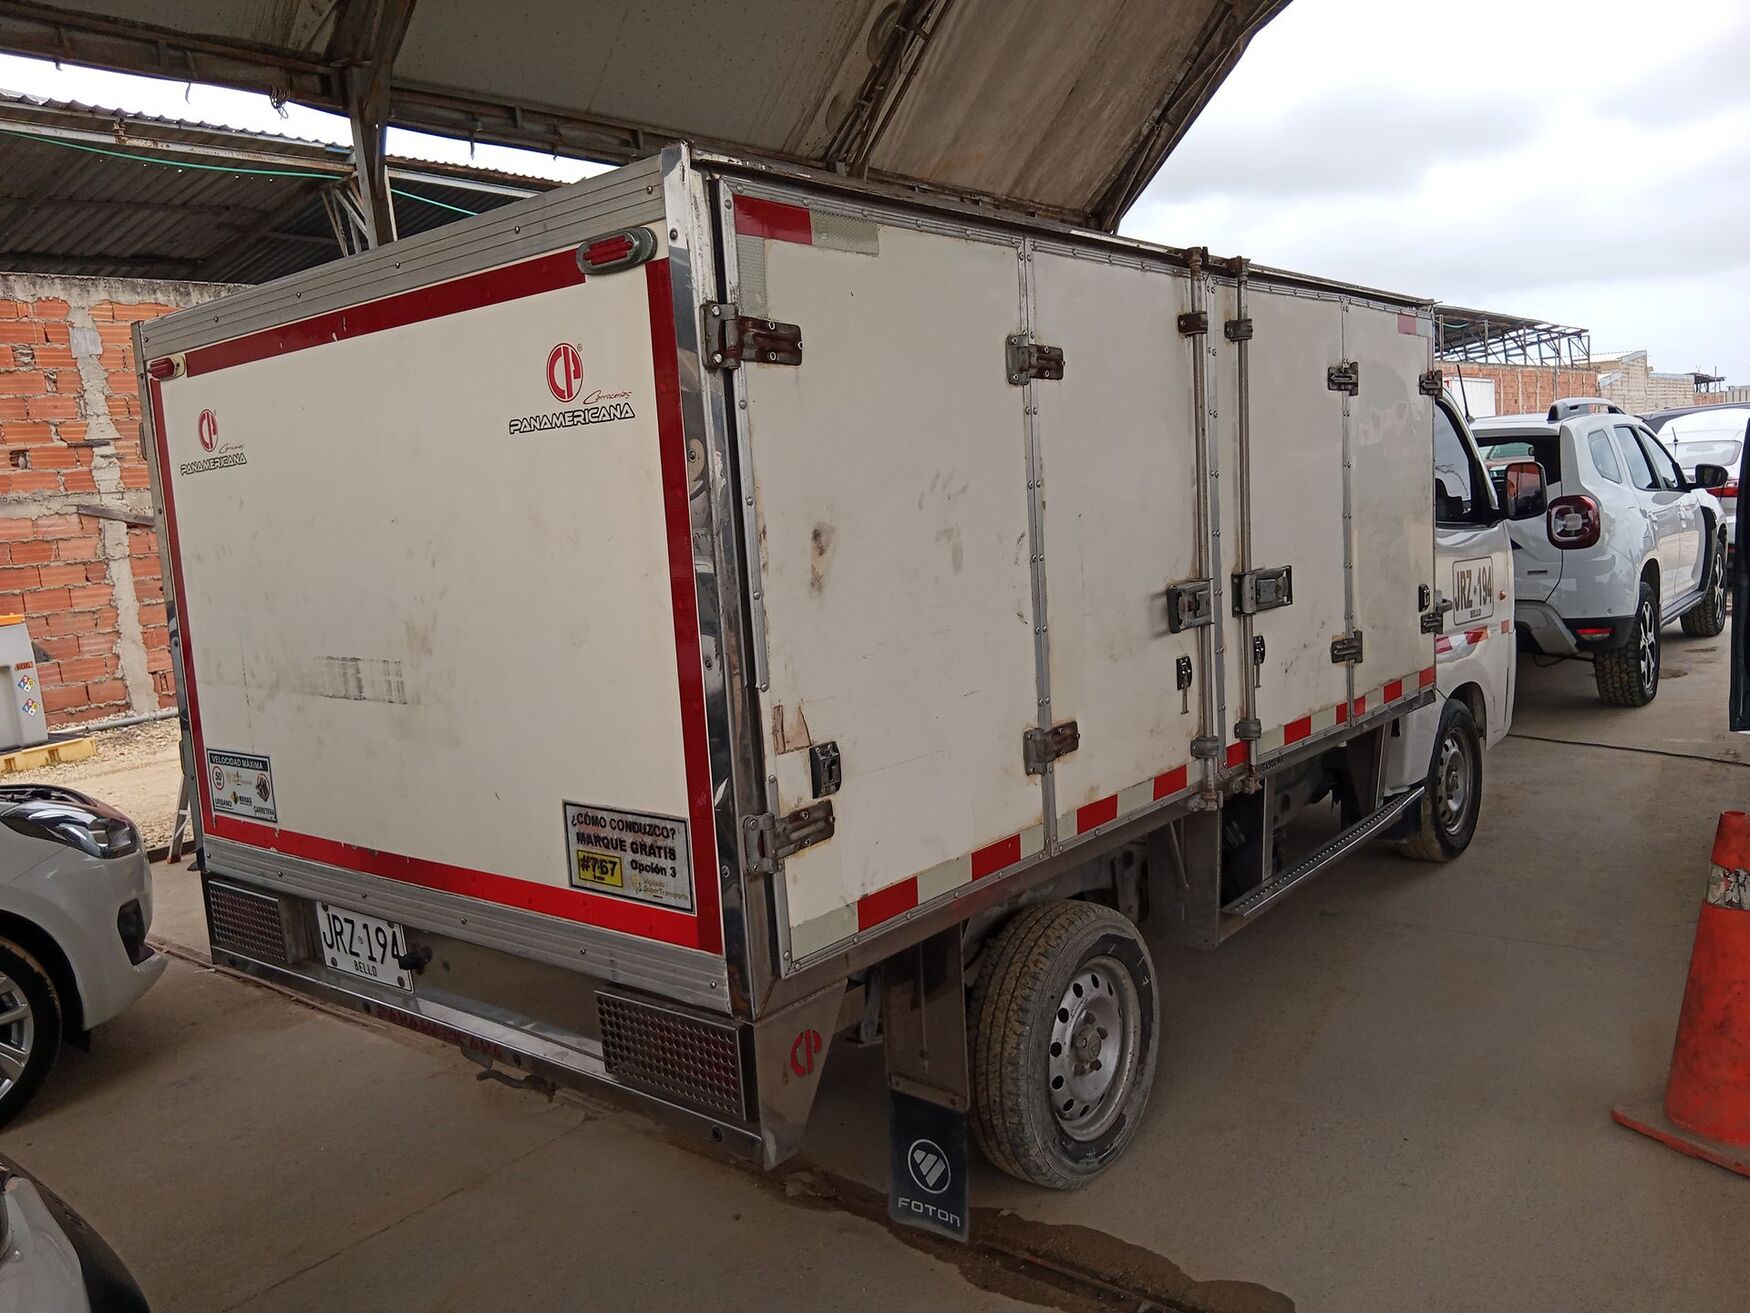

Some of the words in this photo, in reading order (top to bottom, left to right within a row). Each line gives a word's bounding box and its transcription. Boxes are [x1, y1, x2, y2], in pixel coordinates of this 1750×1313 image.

[509, 402, 635, 434] PANAMERICANA
[180, 453, 247, 475] PANAMERICANA
[211, 755, 241, 766] VELOCIDAD
[242, 759, 263, 769] MÁXIMA
[571, 811, 607, 829] ¿CÓMO
[609, 818, 676, 840] CONDUZCO?
[576, 831, 627, 853] MARQUE
[630, 840, 677, 861] GRATIS
[580, 854, 618, 877] #767
[630, 859, 667, 877] Opción
[669, 866, 677, 878] 3
[354, 959, 378, 977] BELLO
